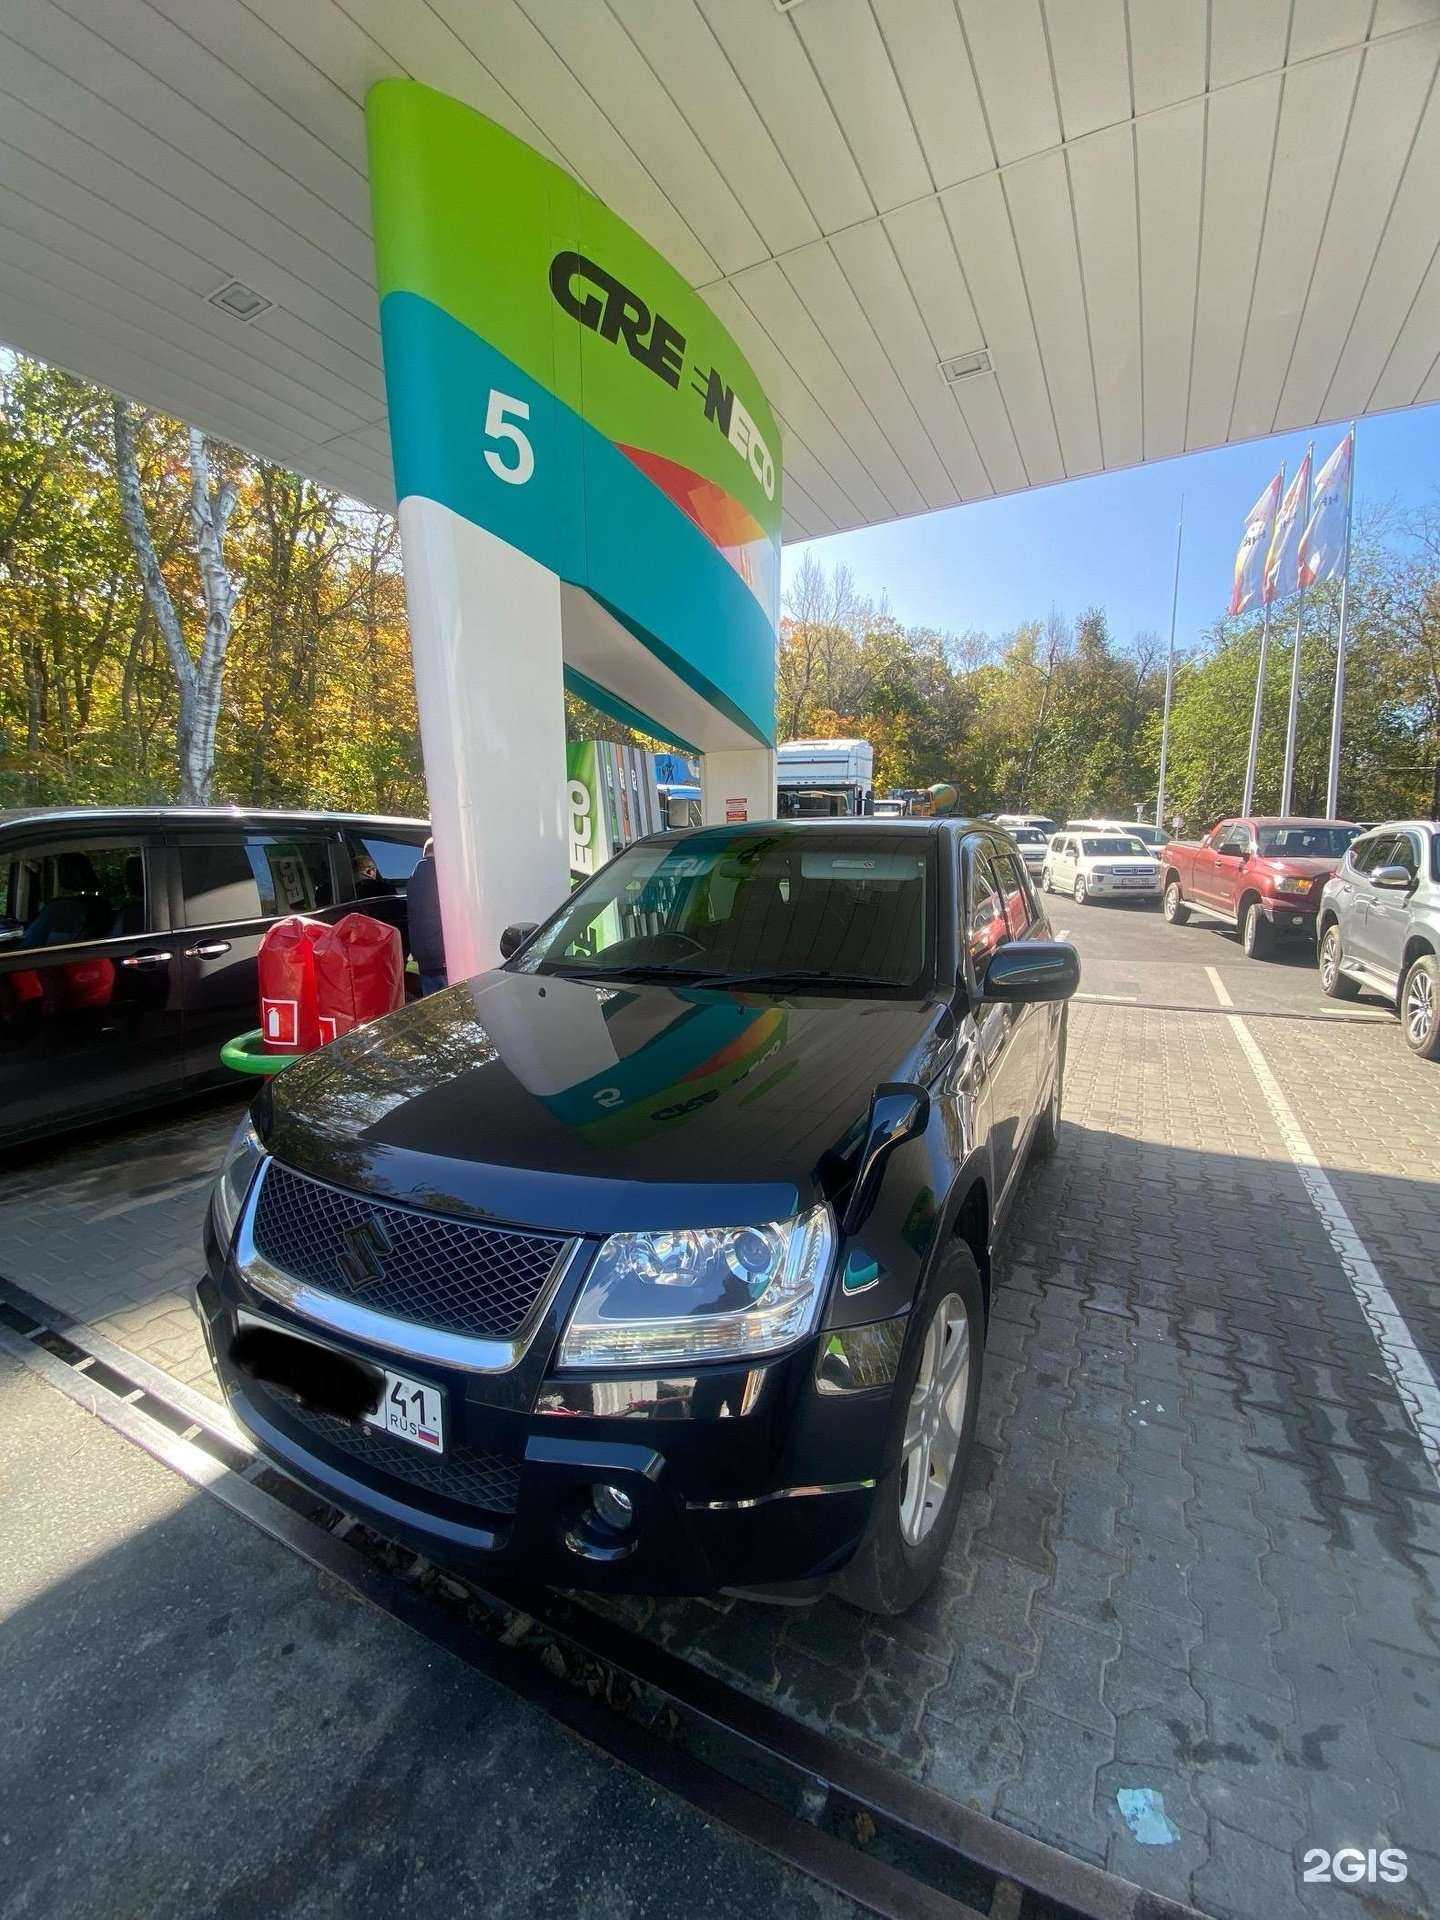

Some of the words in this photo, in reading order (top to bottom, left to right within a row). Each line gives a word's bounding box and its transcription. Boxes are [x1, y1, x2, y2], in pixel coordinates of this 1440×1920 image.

[483, 388, 535, 485] 5
[567, 779, 594, 873] ECO
[391, 1381, 425, 1425] 41
[391, 1414, 417, 1435] RUS
